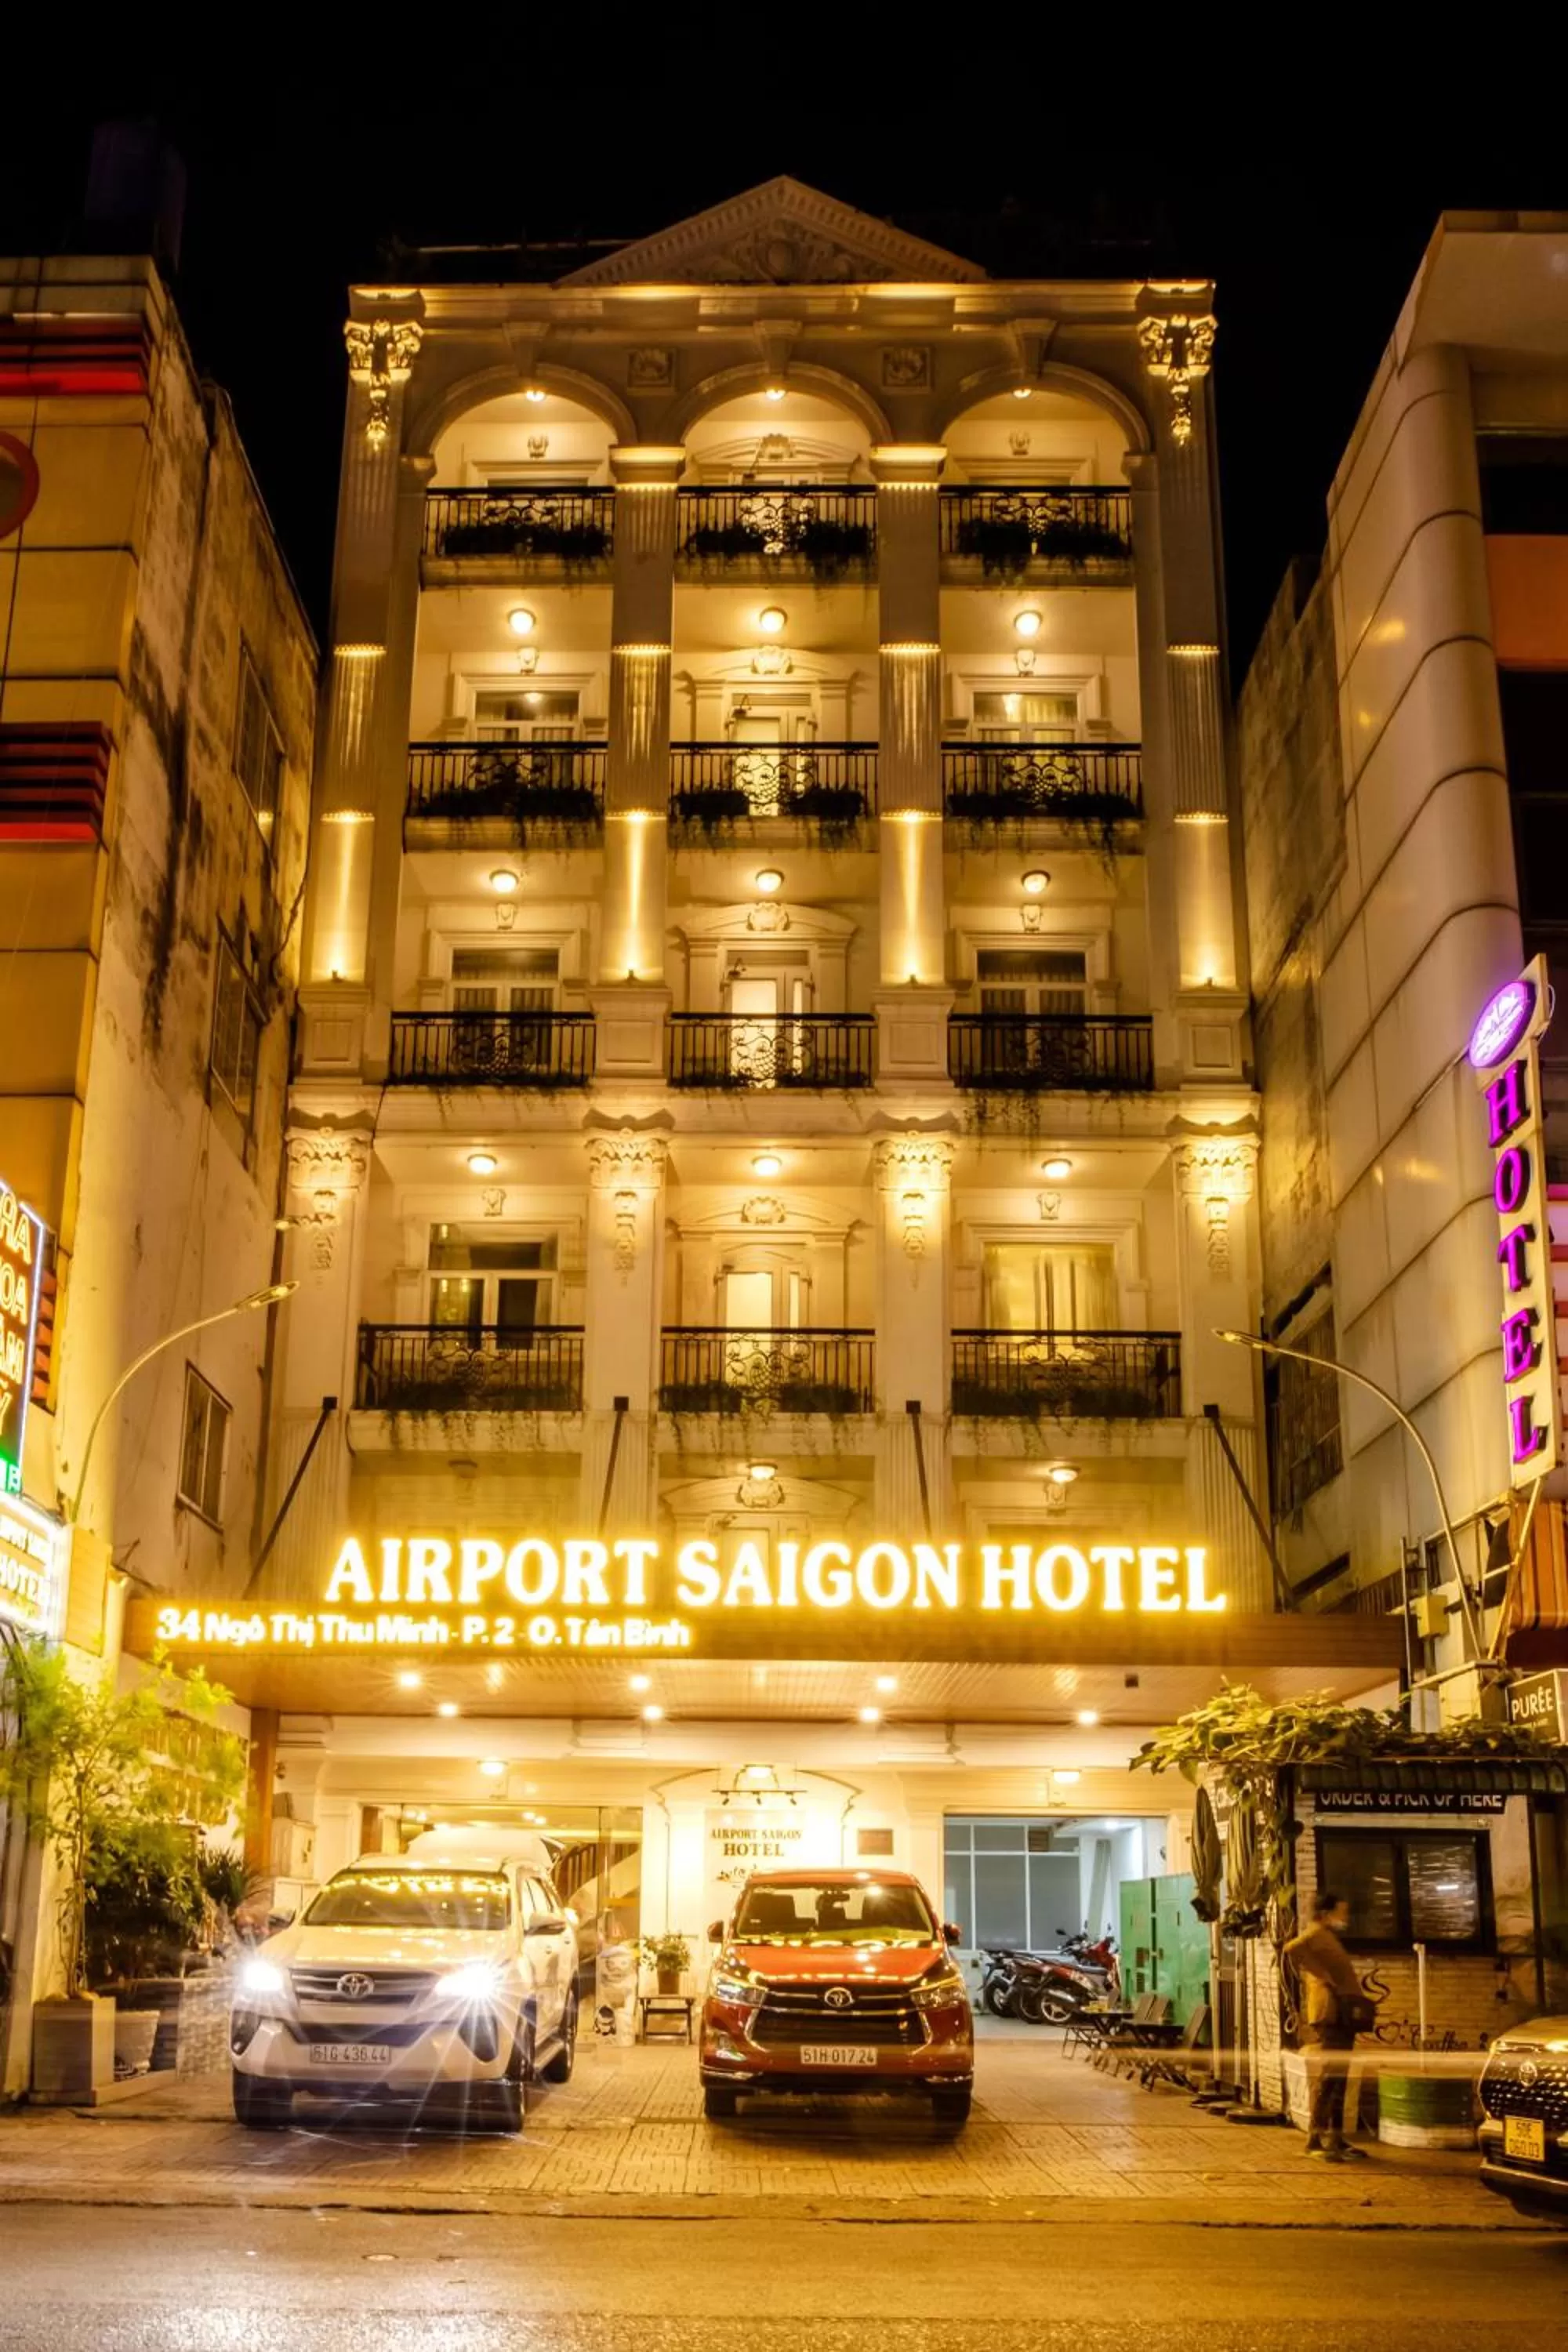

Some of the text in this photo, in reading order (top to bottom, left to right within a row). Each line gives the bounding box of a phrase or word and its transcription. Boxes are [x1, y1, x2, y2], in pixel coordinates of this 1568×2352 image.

[1485, 1058, 1544, 1464] HOTEL
[324, 1537, 1227, 1611] AIRPORT SAIGON HOTEL
[157, 1608, 199, 1641] 34
[270, 1613, 313, 1648] Thị
[317, 1614, 374, 1642] Thu
[376, 1615, 448, 1643] Minh
[711, 1828, 802, 1840] AIRPORT SAIGON
[723, 1842, 784, 1857] HOTEL
